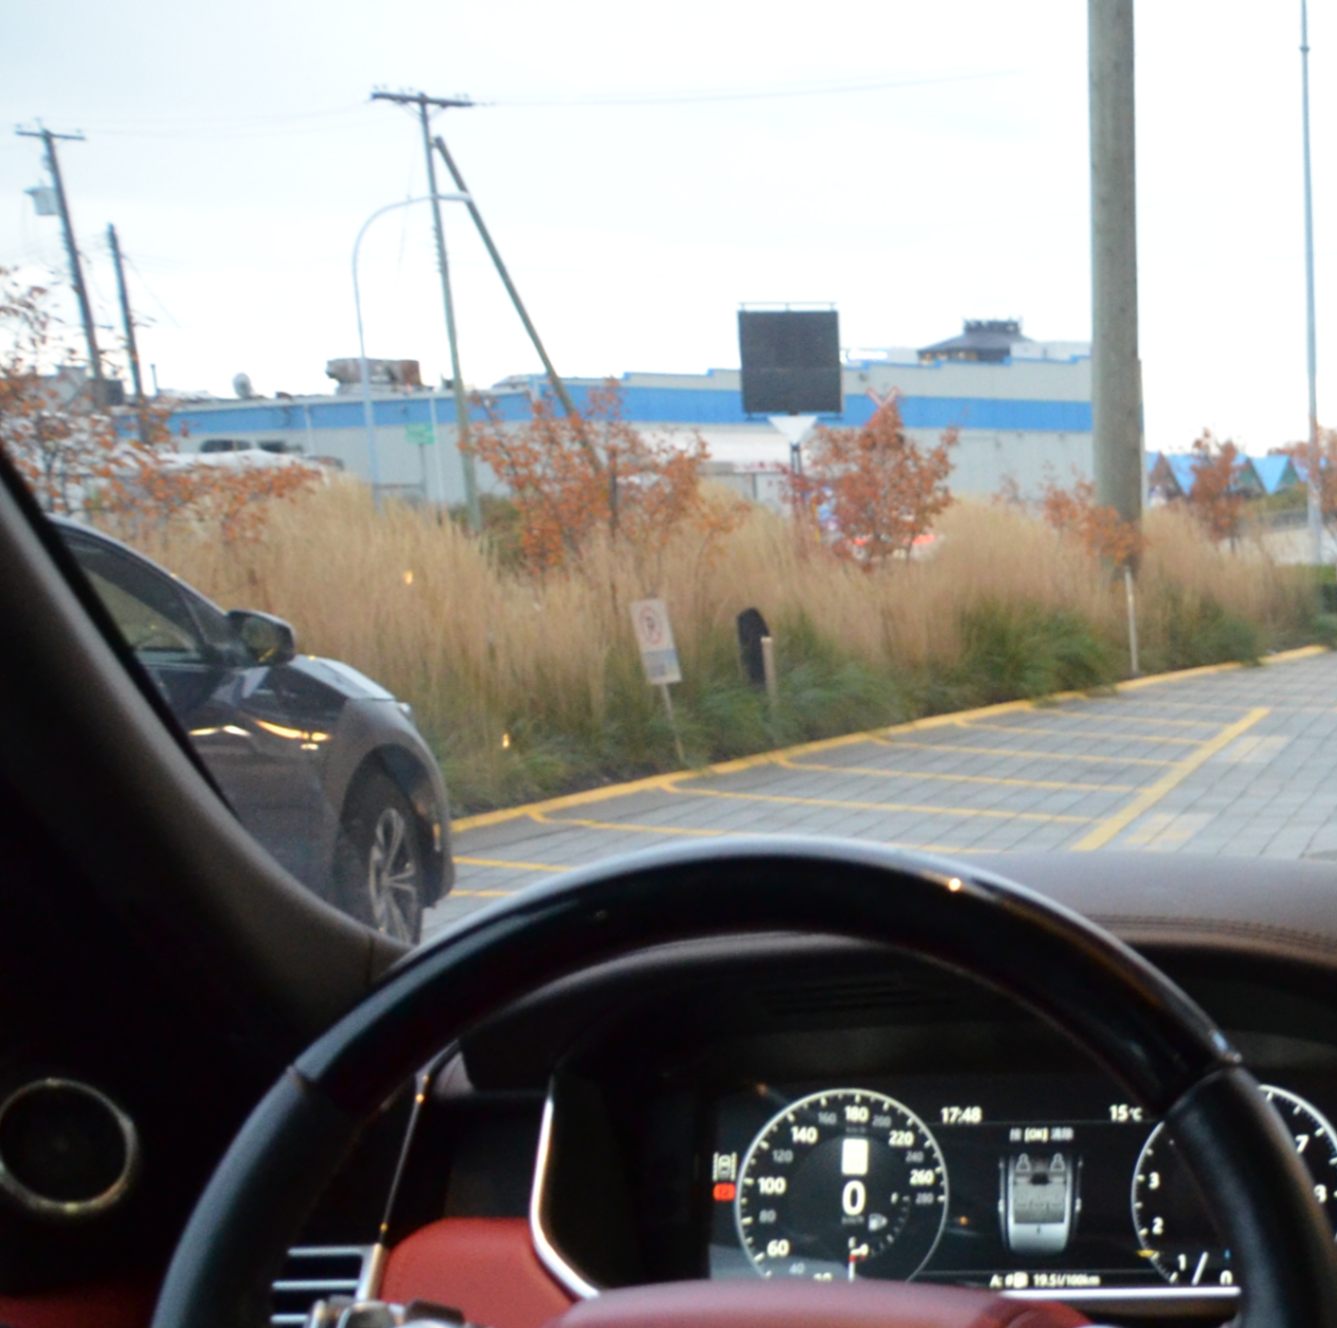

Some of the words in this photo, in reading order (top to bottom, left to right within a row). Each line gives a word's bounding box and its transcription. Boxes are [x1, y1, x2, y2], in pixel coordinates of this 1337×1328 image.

[844, 1105, 869, 1122] 180
[941, 1106, 983, 1124] 17:48
[791, 1126, 818, 1144] 140
[888, 1130, 914, 1146] 220
[758, 1176, 786, 1195] 100
[909, 1169, 934, 1186] 260
[1148, 1172, 1160, 1189] 3
[842, 1180, 866, 1216] 0
[1152, 1217, 1164, 1235] 2
[766, 1239, 790, 1257] 60
[1178, 1253, 1187, 1271] 1
